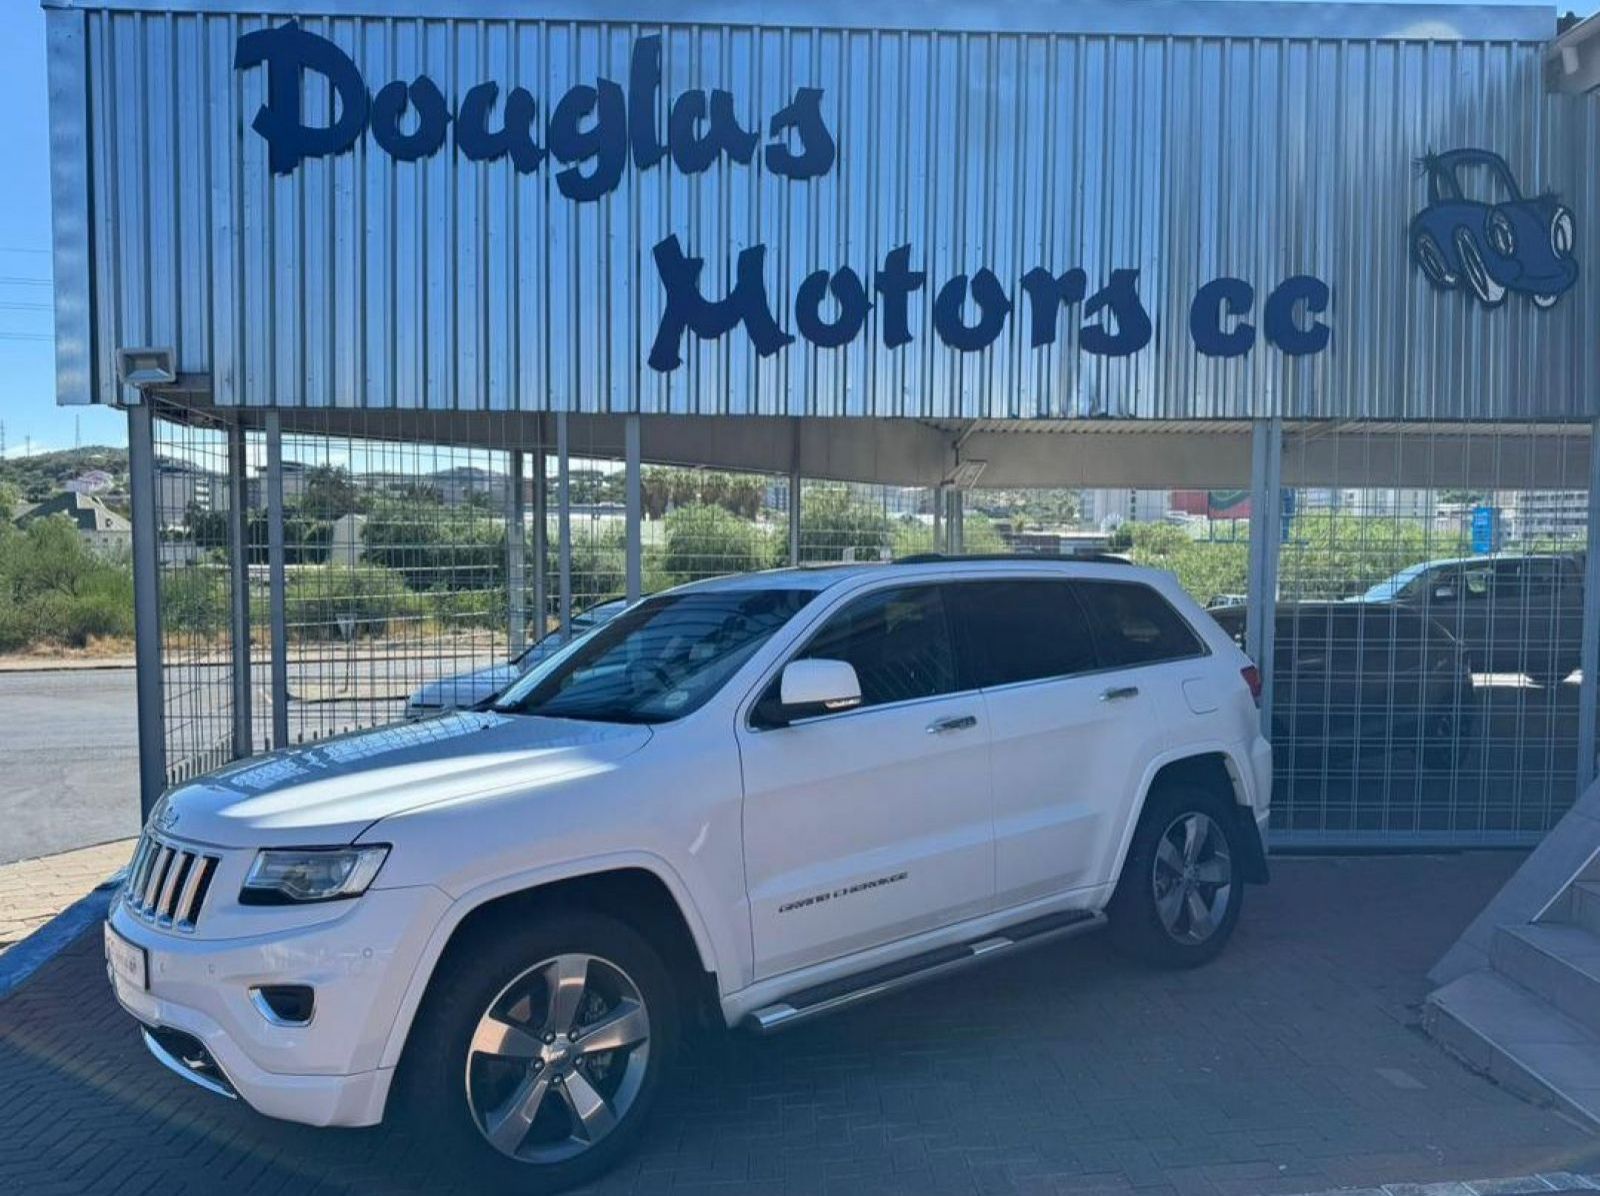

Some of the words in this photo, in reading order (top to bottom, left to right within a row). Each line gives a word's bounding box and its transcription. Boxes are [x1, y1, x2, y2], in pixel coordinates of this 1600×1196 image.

[234, 19, 836, 202] Douglas
[648, 233, 1152, 372] Motors
[1190, 275, 1331, 358] cc
